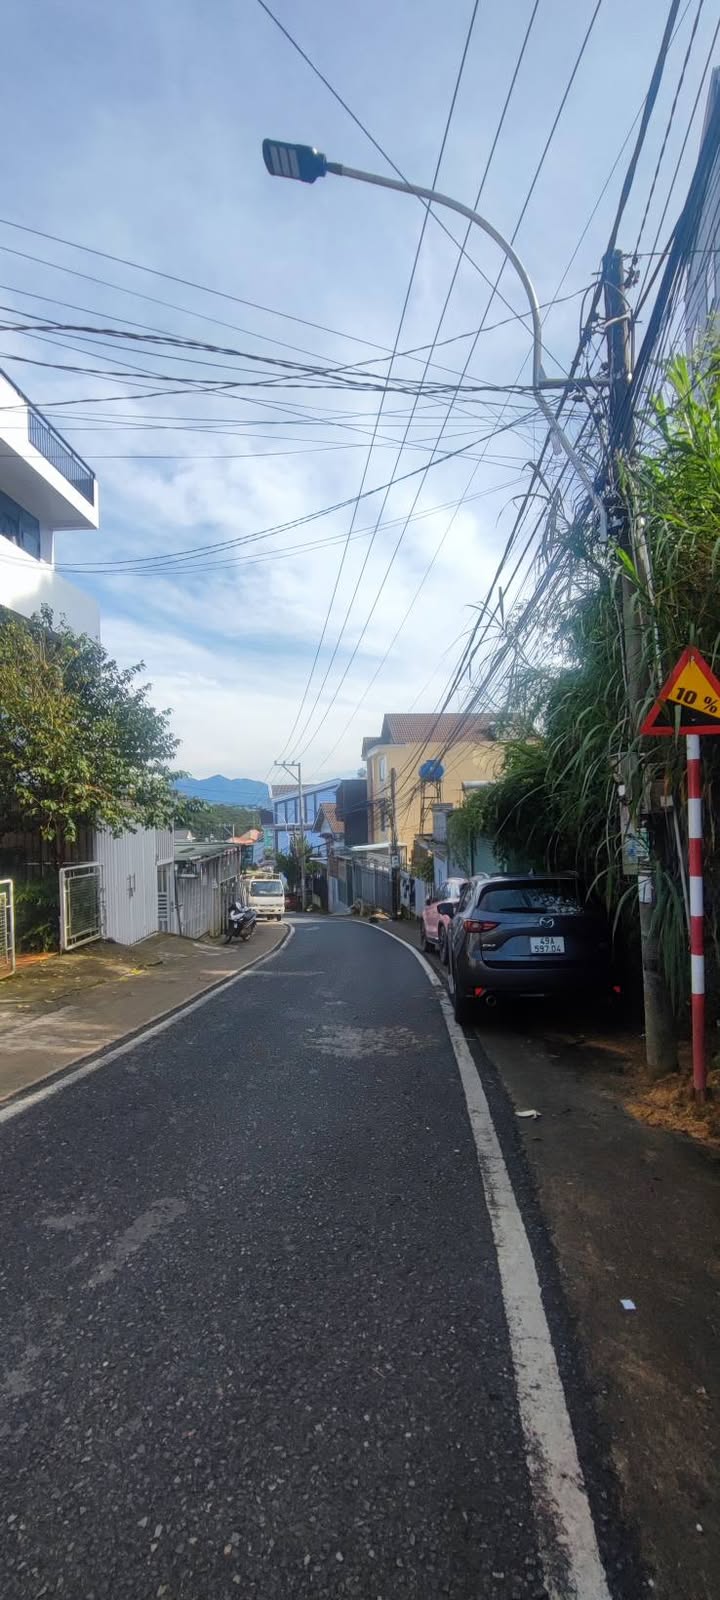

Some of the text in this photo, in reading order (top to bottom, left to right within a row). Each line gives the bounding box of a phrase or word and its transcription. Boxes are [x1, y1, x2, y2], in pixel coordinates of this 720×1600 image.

[676, 688, 718, 713] 10 %
[540, 937, 555, 945] 49A
